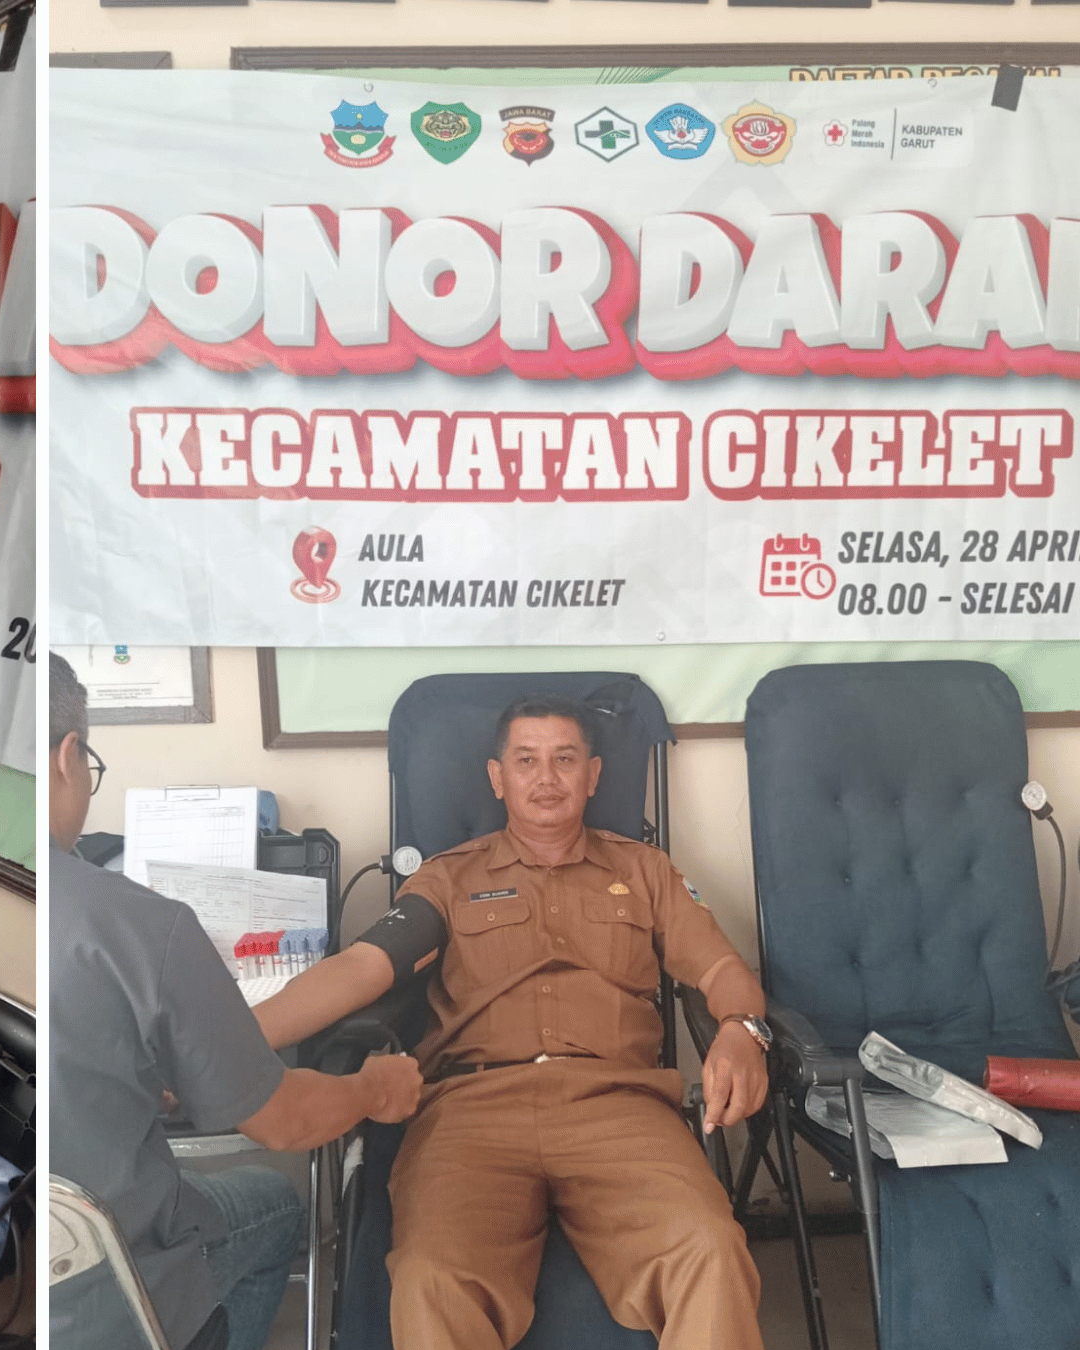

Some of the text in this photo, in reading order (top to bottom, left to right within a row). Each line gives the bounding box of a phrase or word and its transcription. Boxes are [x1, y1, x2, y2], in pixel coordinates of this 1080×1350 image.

[901, 125, 963, 136] KABUPATEN
[901, 138, 935, 149] GARUT
[49, 204, 1080, 380] DONOR DARA
[130, 407, 1073, 503] KECAMATAN CIKELET
[358, 534, 424, 562] AULA
[838, 529, 1080, 568] SELASA, 28 APRI
[361, 578, 625, 608] KECAMATAN CIKELET
[838, 583, 927, 615] 08.00
[960, 582, 1076, 614] SELESAI
